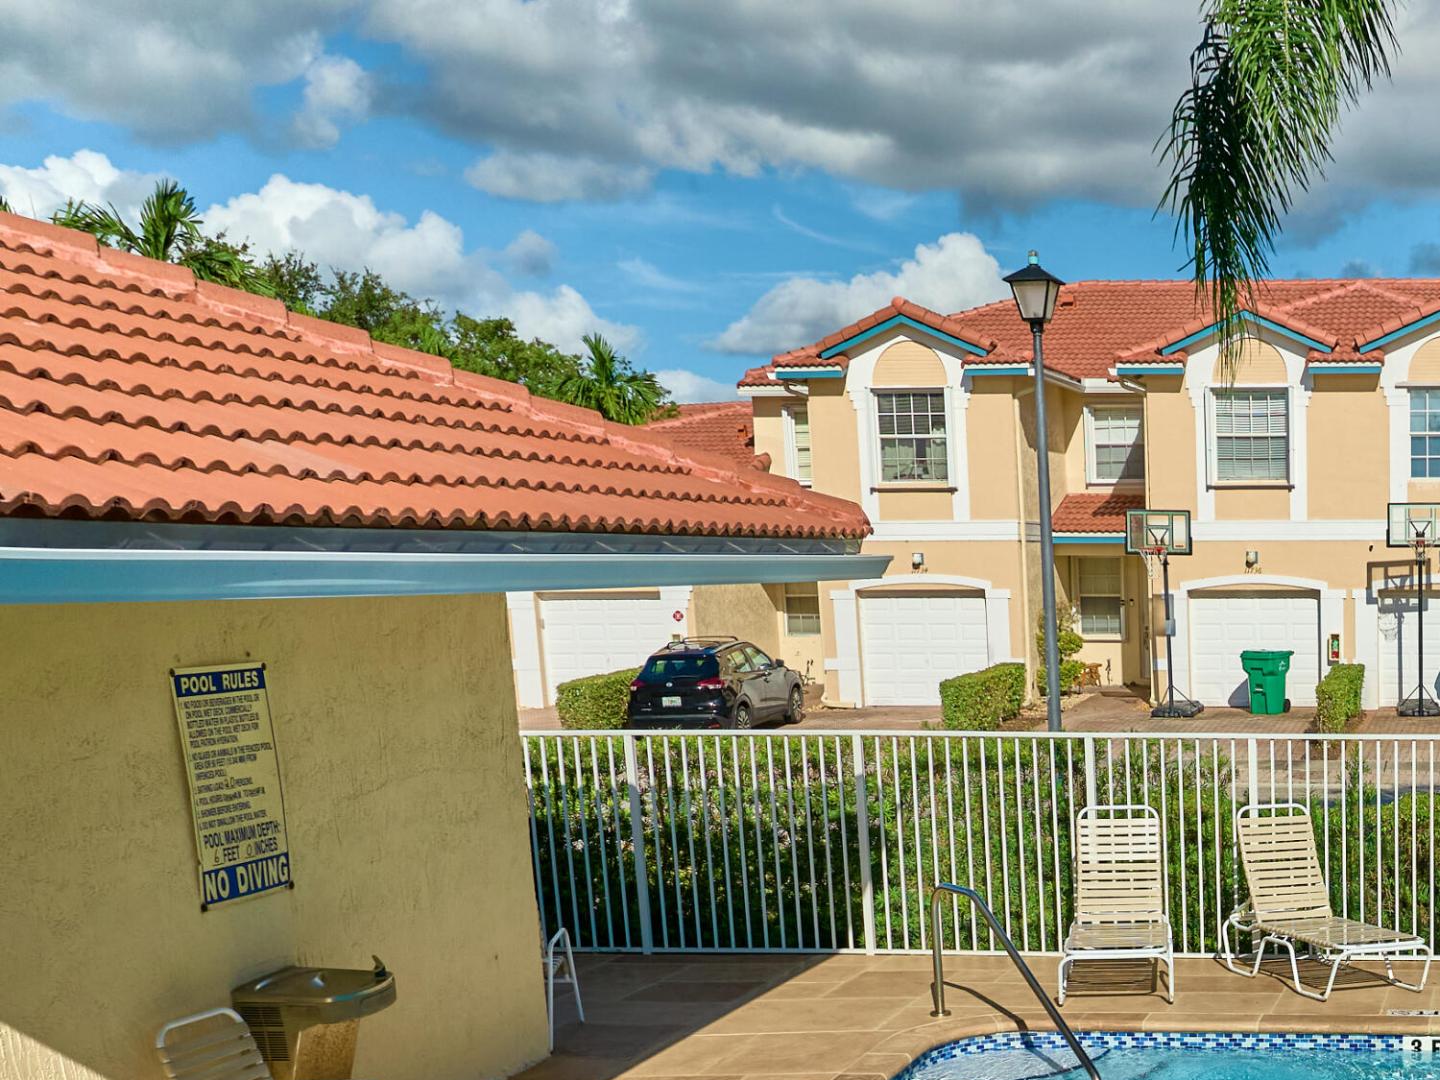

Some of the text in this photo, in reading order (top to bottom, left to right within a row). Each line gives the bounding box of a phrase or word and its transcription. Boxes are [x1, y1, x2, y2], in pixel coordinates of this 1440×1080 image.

[180, 670, 259, 694] POOL RULES
[203, 832, 225, 850] POOL
[224, 824, 256, 845] MAXIMUM
[257, 820, 280, 838] DEPTH
[223, 845, 240, 862] FEET
[255, 836, 278, 855] INCHES
[204, 855, 289, 902] NO DIVING
[1411, 1039, 1422, 1053] 3
